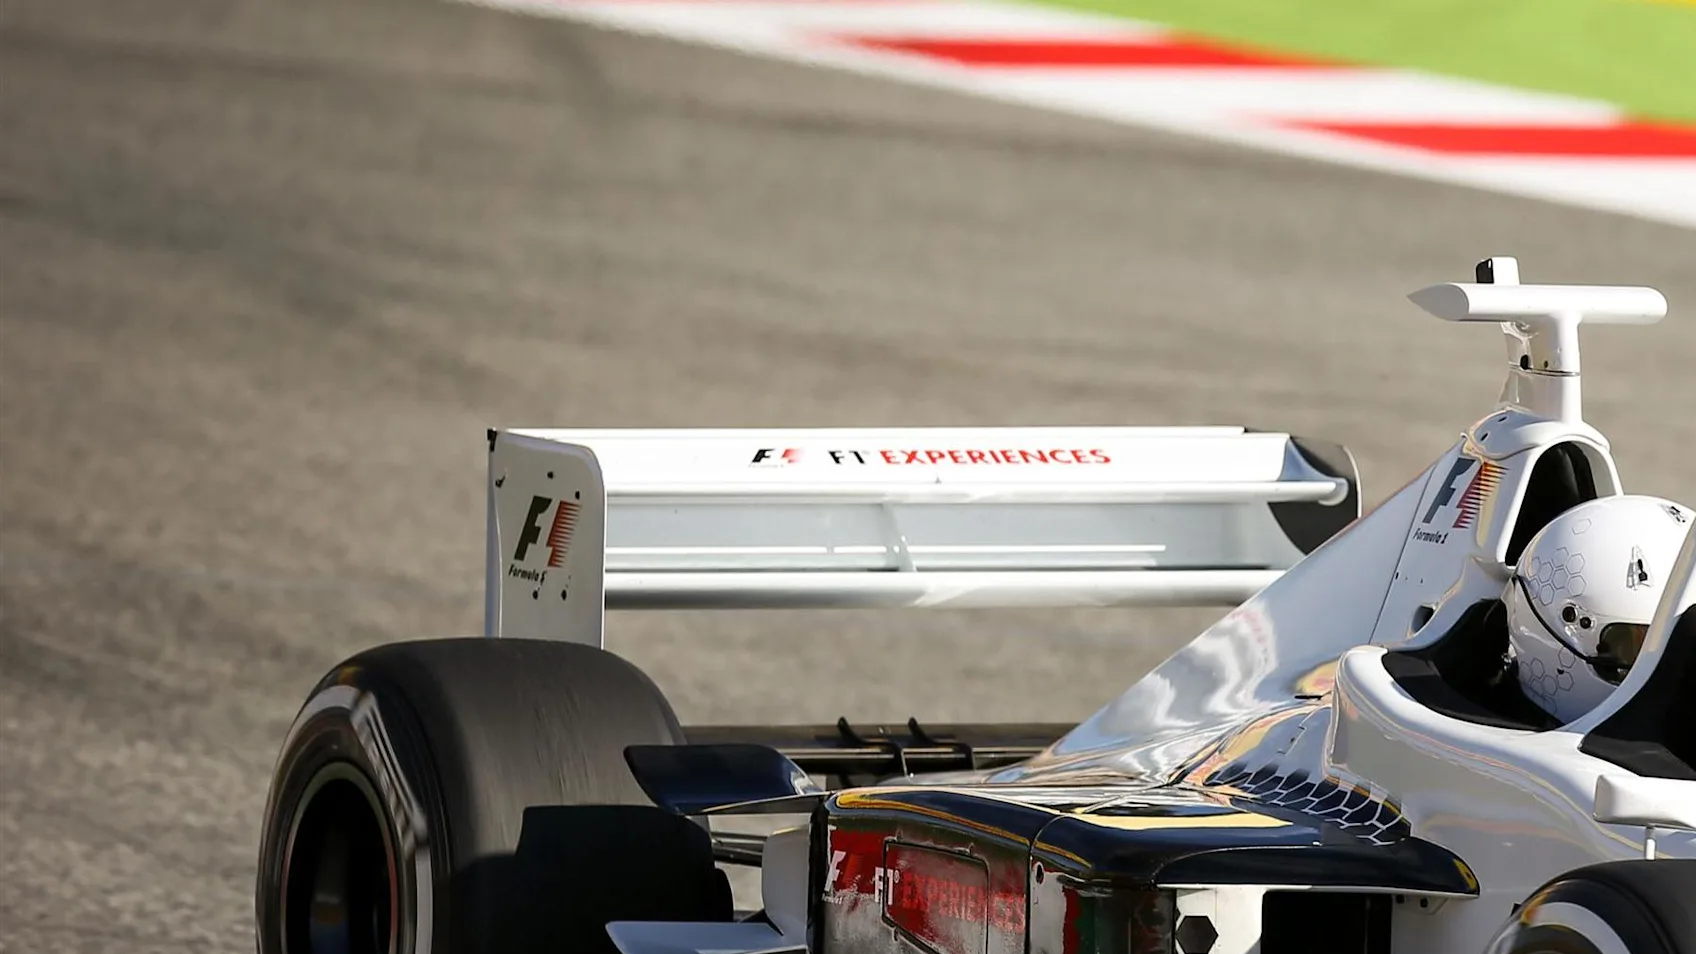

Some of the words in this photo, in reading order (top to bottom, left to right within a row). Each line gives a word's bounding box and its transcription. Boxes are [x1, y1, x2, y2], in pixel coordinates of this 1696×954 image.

[880, 449, 1111, 464] EXPERIENCES
[1422, 457, 1511, 529] F1
[514, 495, 582, 568] F1
[508, 564, 541, 583] Formula
